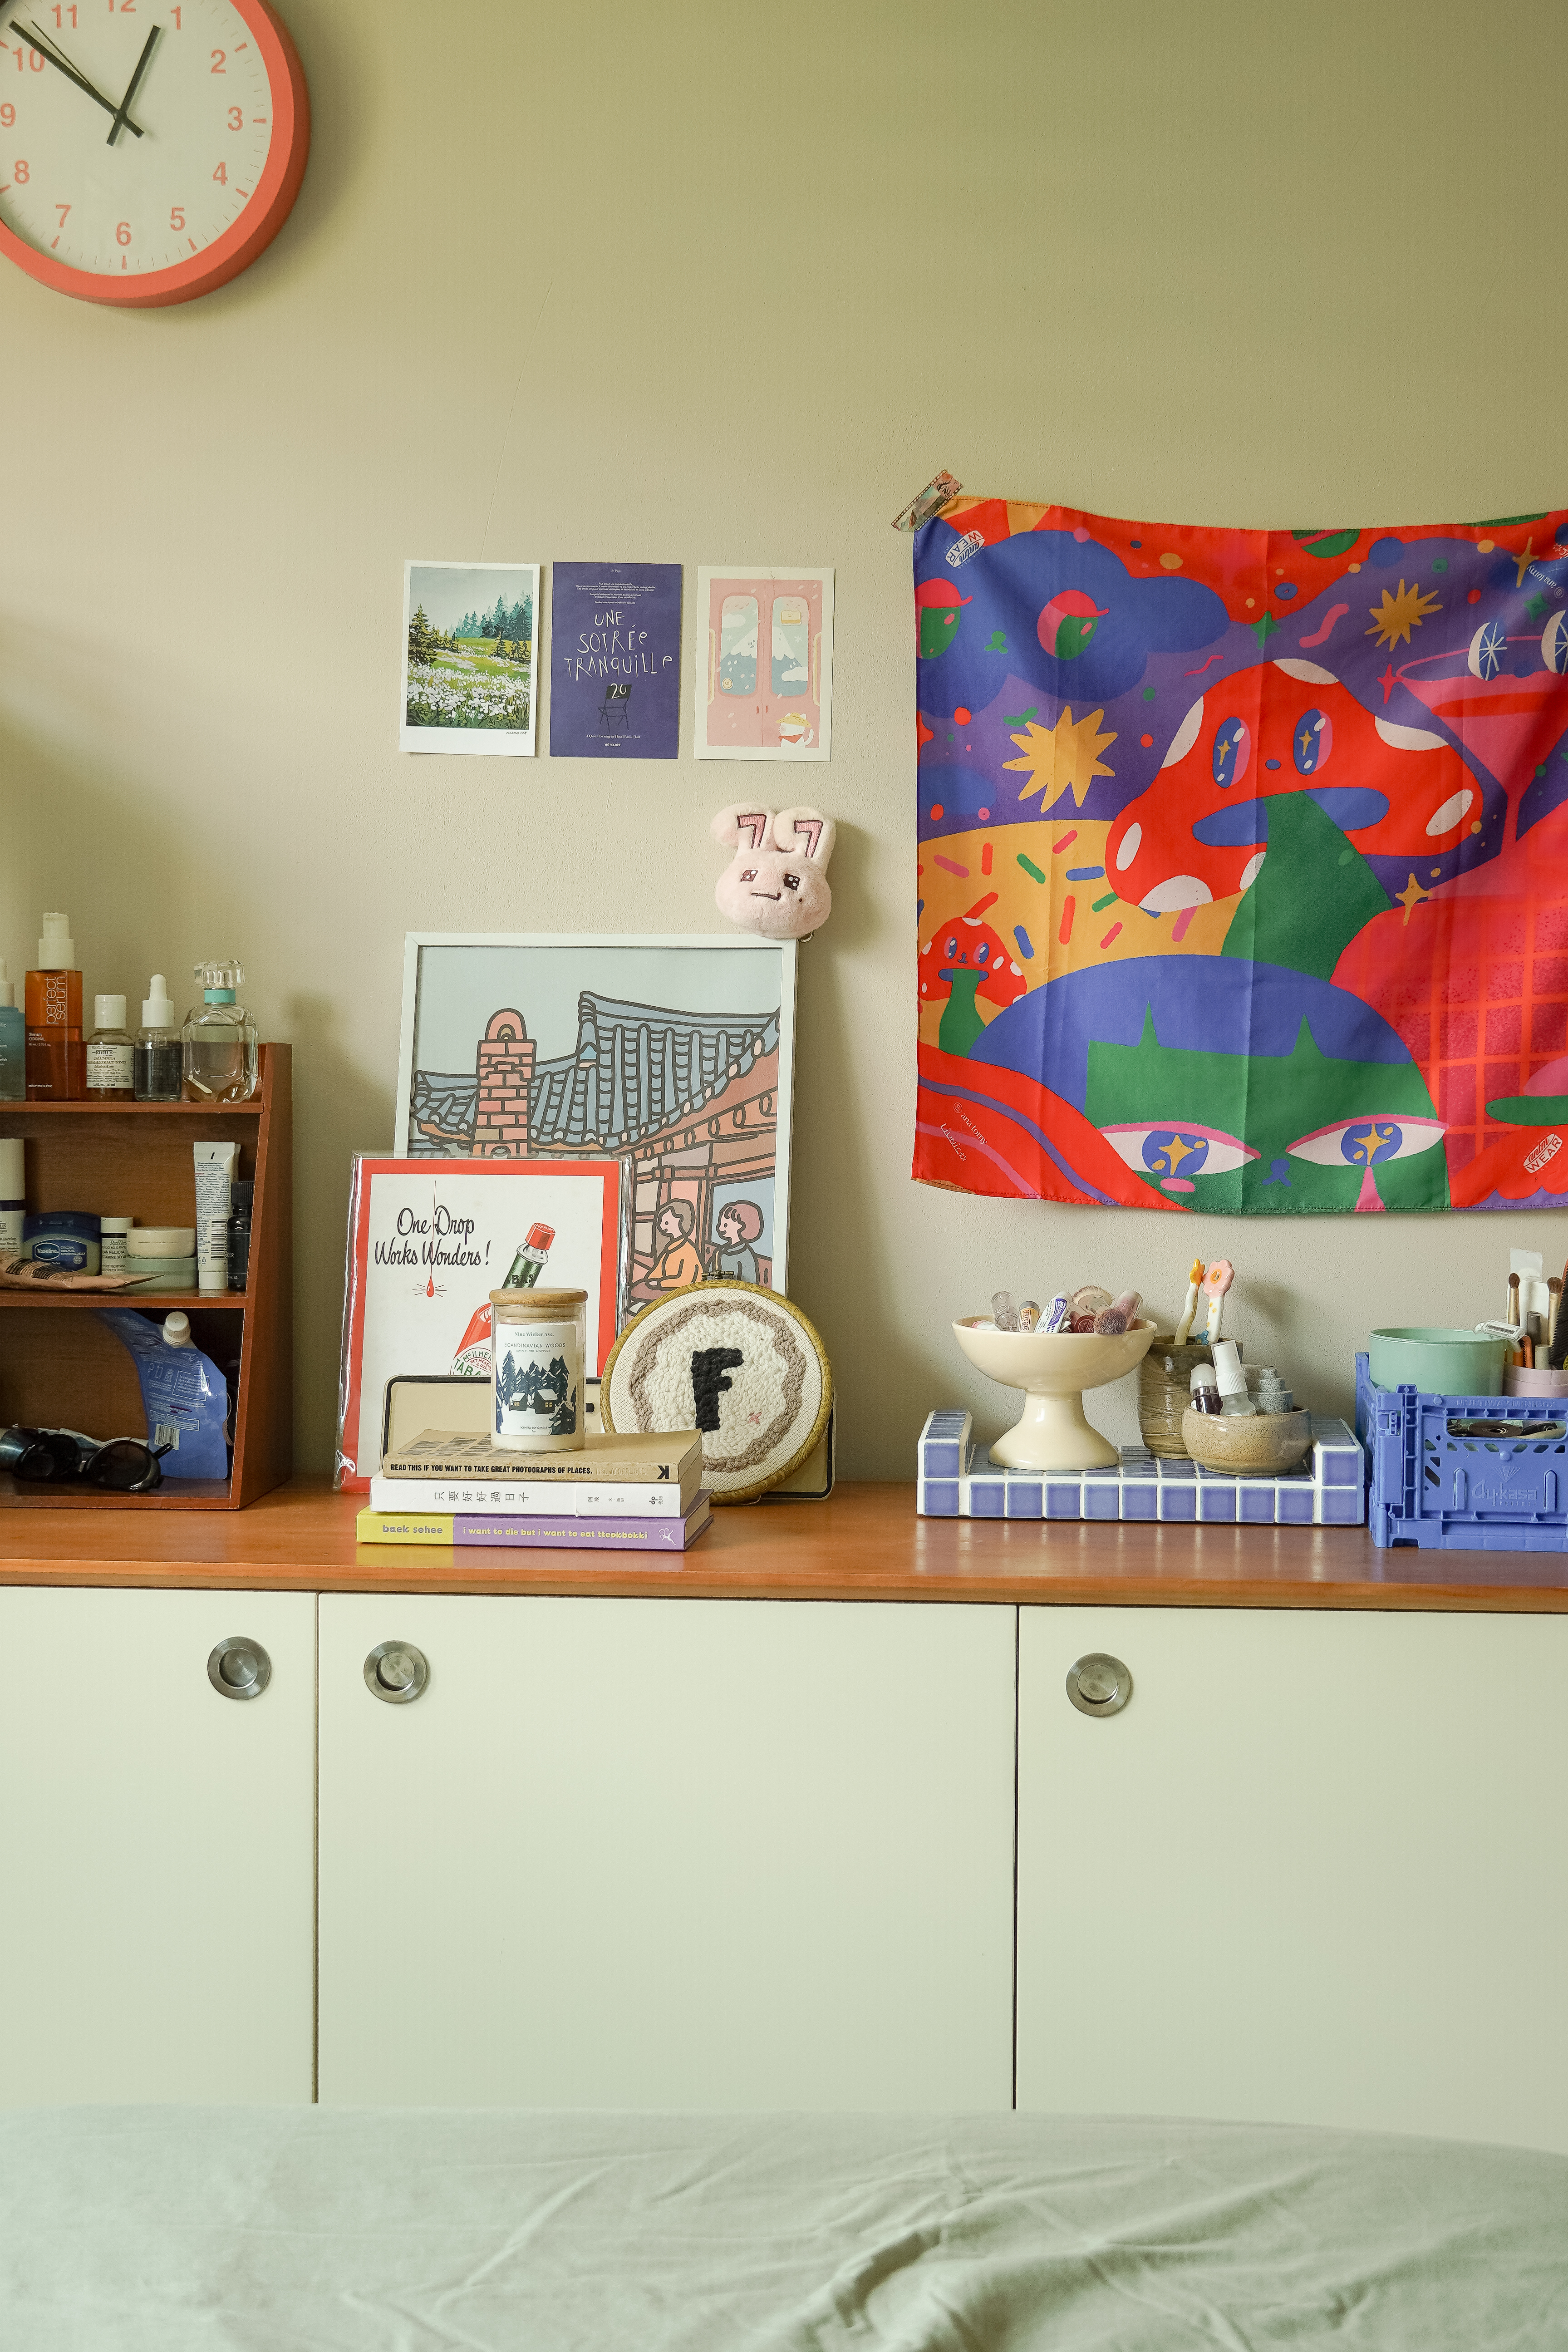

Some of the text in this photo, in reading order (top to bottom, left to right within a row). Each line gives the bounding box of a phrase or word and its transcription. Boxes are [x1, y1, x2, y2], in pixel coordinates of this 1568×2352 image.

[51, 5, 78, 29] 11
[171, 6, 182, 30] 1
[13, 47, 45, 72] 10
[211, 50, 226, 74] 2
[0, 103, 16, 128] 9
[227, 107, 243, 131] 3
[15, 160, 30, 184] 8
[212, 162, 228, 186] 4
[55, 205, 71, 228] 7
[170, 207, 185, 231] 5
[116, 222, 132, 246] 6
[595, 610, 624, 627] UNE
[610, 683, 627, 699] 20
[43, 977, 59, 1024] perfect
[56, 977, 66, 1020] serum
[1527, 1138, 1561, 1171] WEAR
[397, 1206, 474, 1245] One Drop
[375, 1237, 418, 1265] Works
[690, 1347, 744, 1433] F
[657, 1465, 669, 1479] K
[435, 1491, 529, 1502] 只要好好過日子
[383, 1525, 443, 1534] baek sehee
[597, 1530, 648, 1539] tteokbokki
